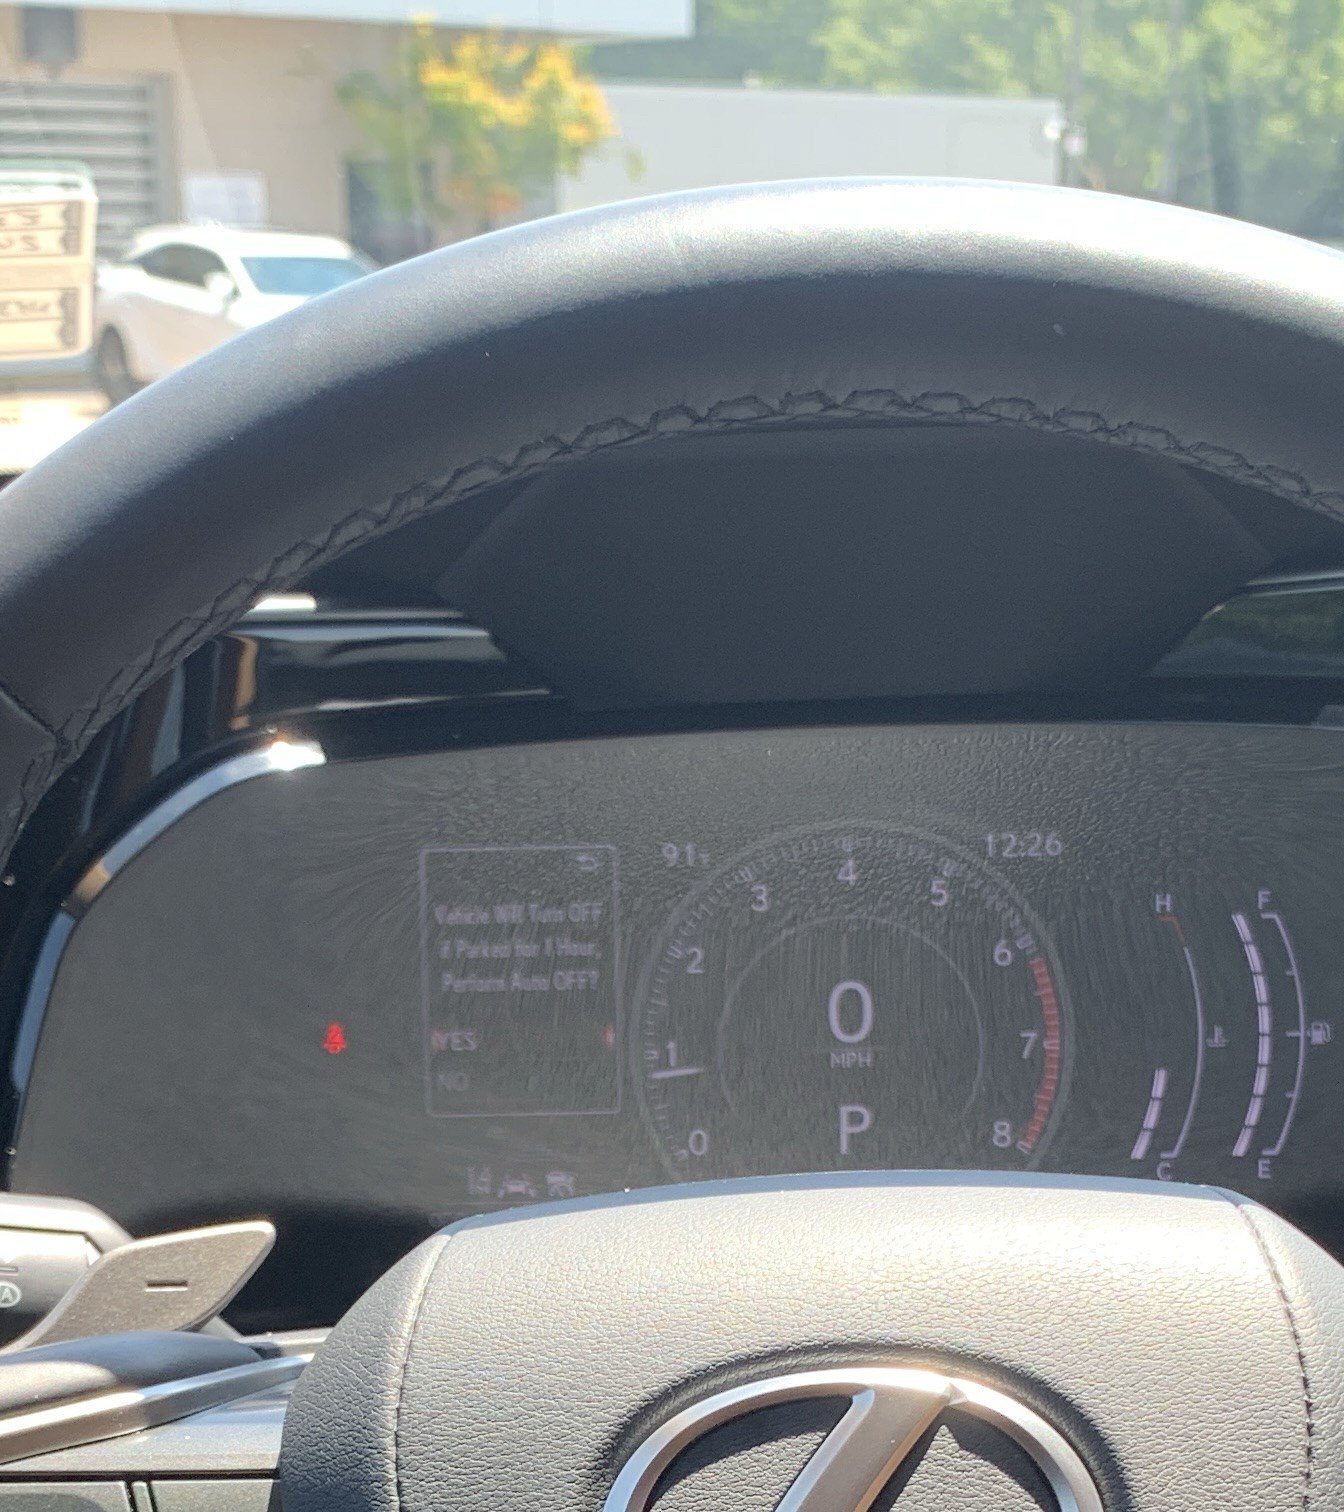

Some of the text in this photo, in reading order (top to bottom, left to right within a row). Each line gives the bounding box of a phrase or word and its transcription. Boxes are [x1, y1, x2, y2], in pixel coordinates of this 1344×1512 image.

[986, 833, 1061, 858] 12:26
[837, 859, 857, 886] 4
[751, 884, 770, 911] 3
[931, 880, 949, 906] 5
[1156, 894, 1171, 912] H
[1258, 890, 1271, 909] F
[567, 903, 603, 922] OFF
[686, 947, 703, 974] 2
[994, 940, 1012, 966] 6
[828, 980, 873, 1044] 0
[436, 1030, 477, 1051] YES
[666, 1040, 677, 1066] 1
[1020, 1031, 1037, 1059] 7
[830, 1052, 872, 1068] MPH
[688, 1129, 707, 1155] 0
[840, 1105, 872, 1154] P
[993, 1121, 1011, 1147] 8
[1157, 1162, 1172, 1180] C
[1258, 1160, 1271, 1179] E
